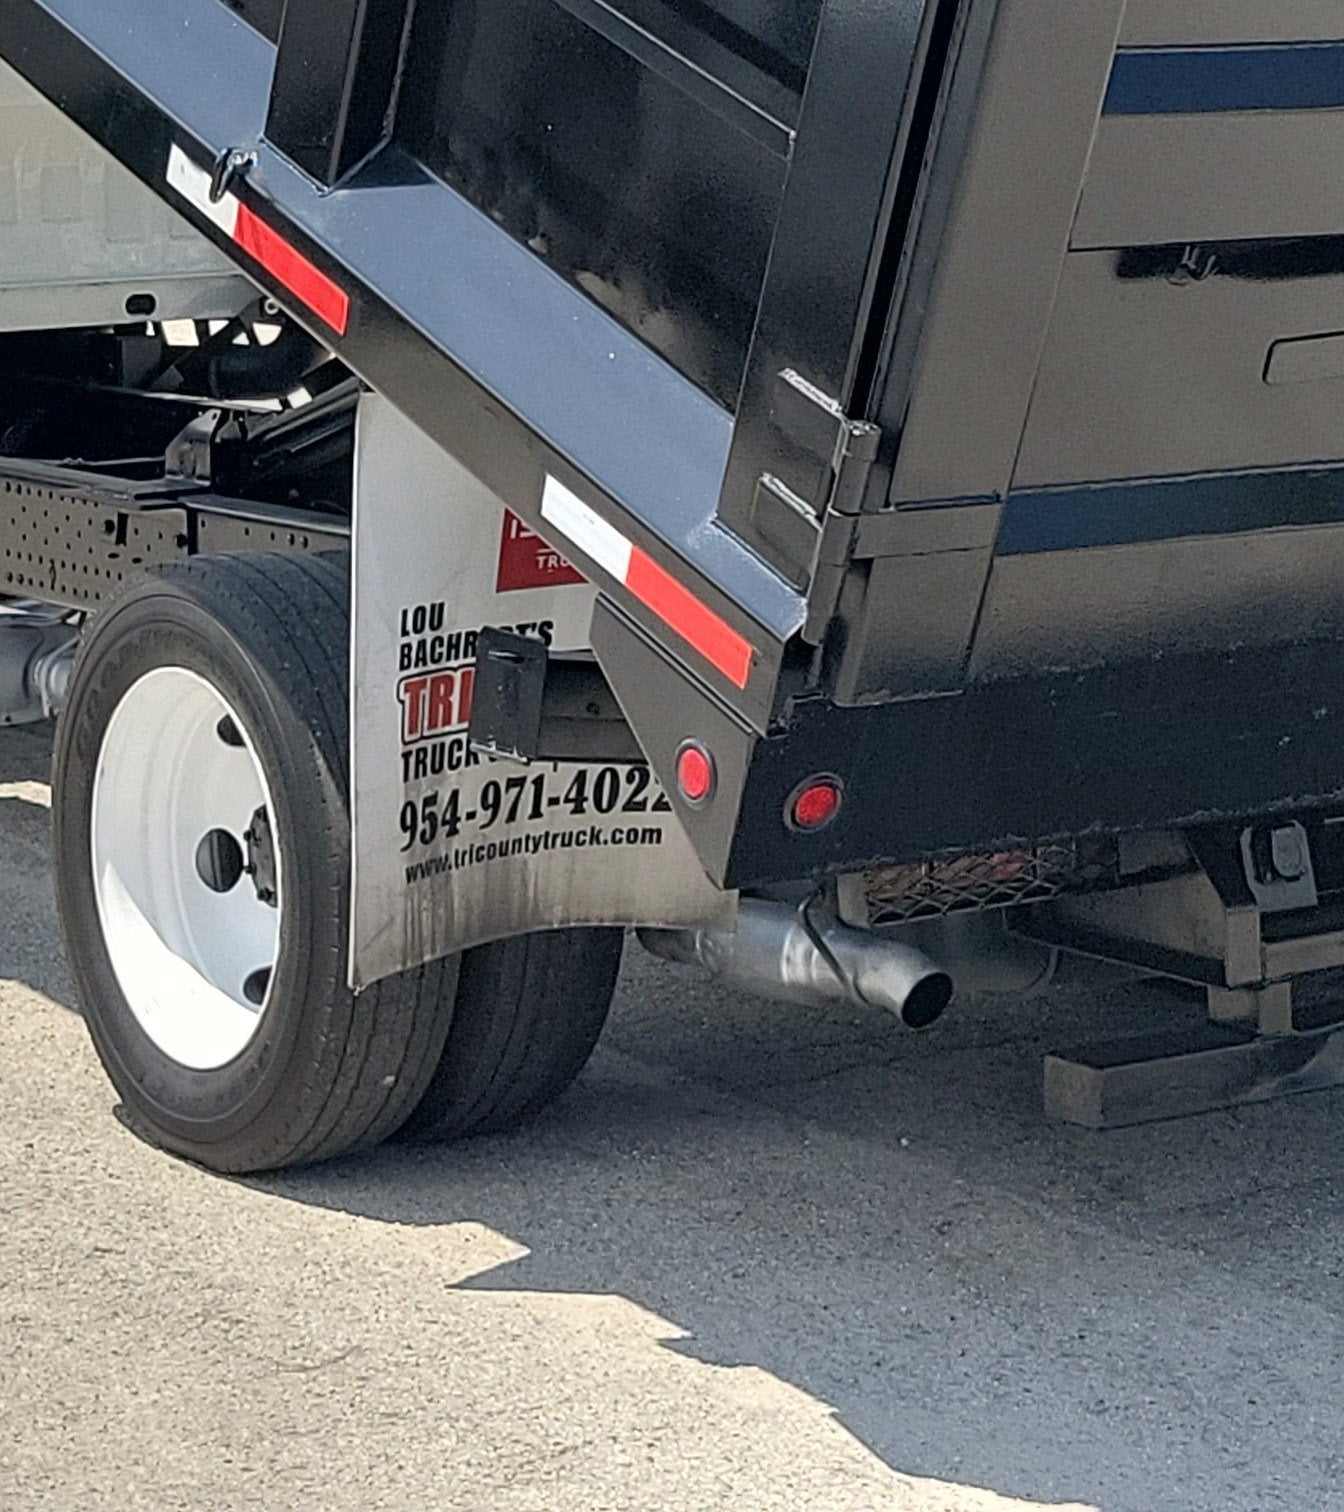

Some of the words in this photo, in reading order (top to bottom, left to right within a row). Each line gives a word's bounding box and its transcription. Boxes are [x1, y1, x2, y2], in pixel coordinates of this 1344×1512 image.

[399, 620, 554, 671] BACHRT'S
[401, 601, 445, 638] LOU
[403, 669, 473, 735] TRI
[405, 825, 662, 884] www.tricountytruck.com
